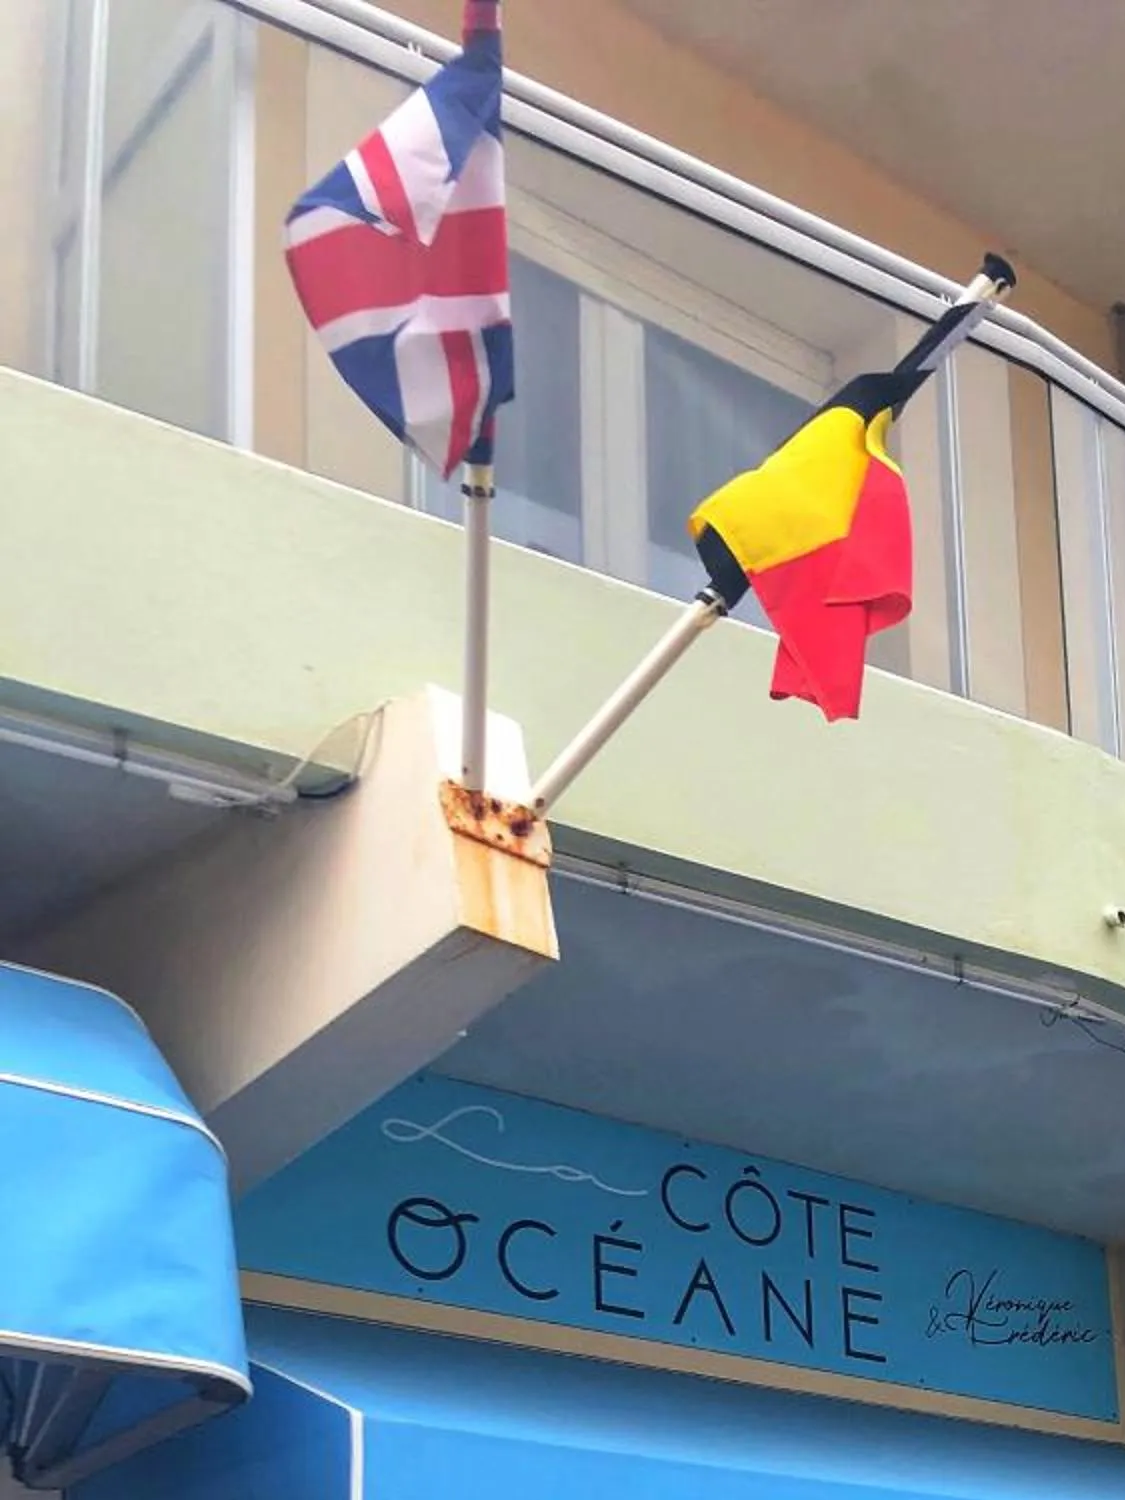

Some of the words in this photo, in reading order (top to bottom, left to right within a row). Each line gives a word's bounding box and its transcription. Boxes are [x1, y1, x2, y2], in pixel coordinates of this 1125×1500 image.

[660, 1164, 880, 1273] CÔTE
[387, 1196, 887, 1363] OCÉANE
[925, 1304, 946, 1339] &
